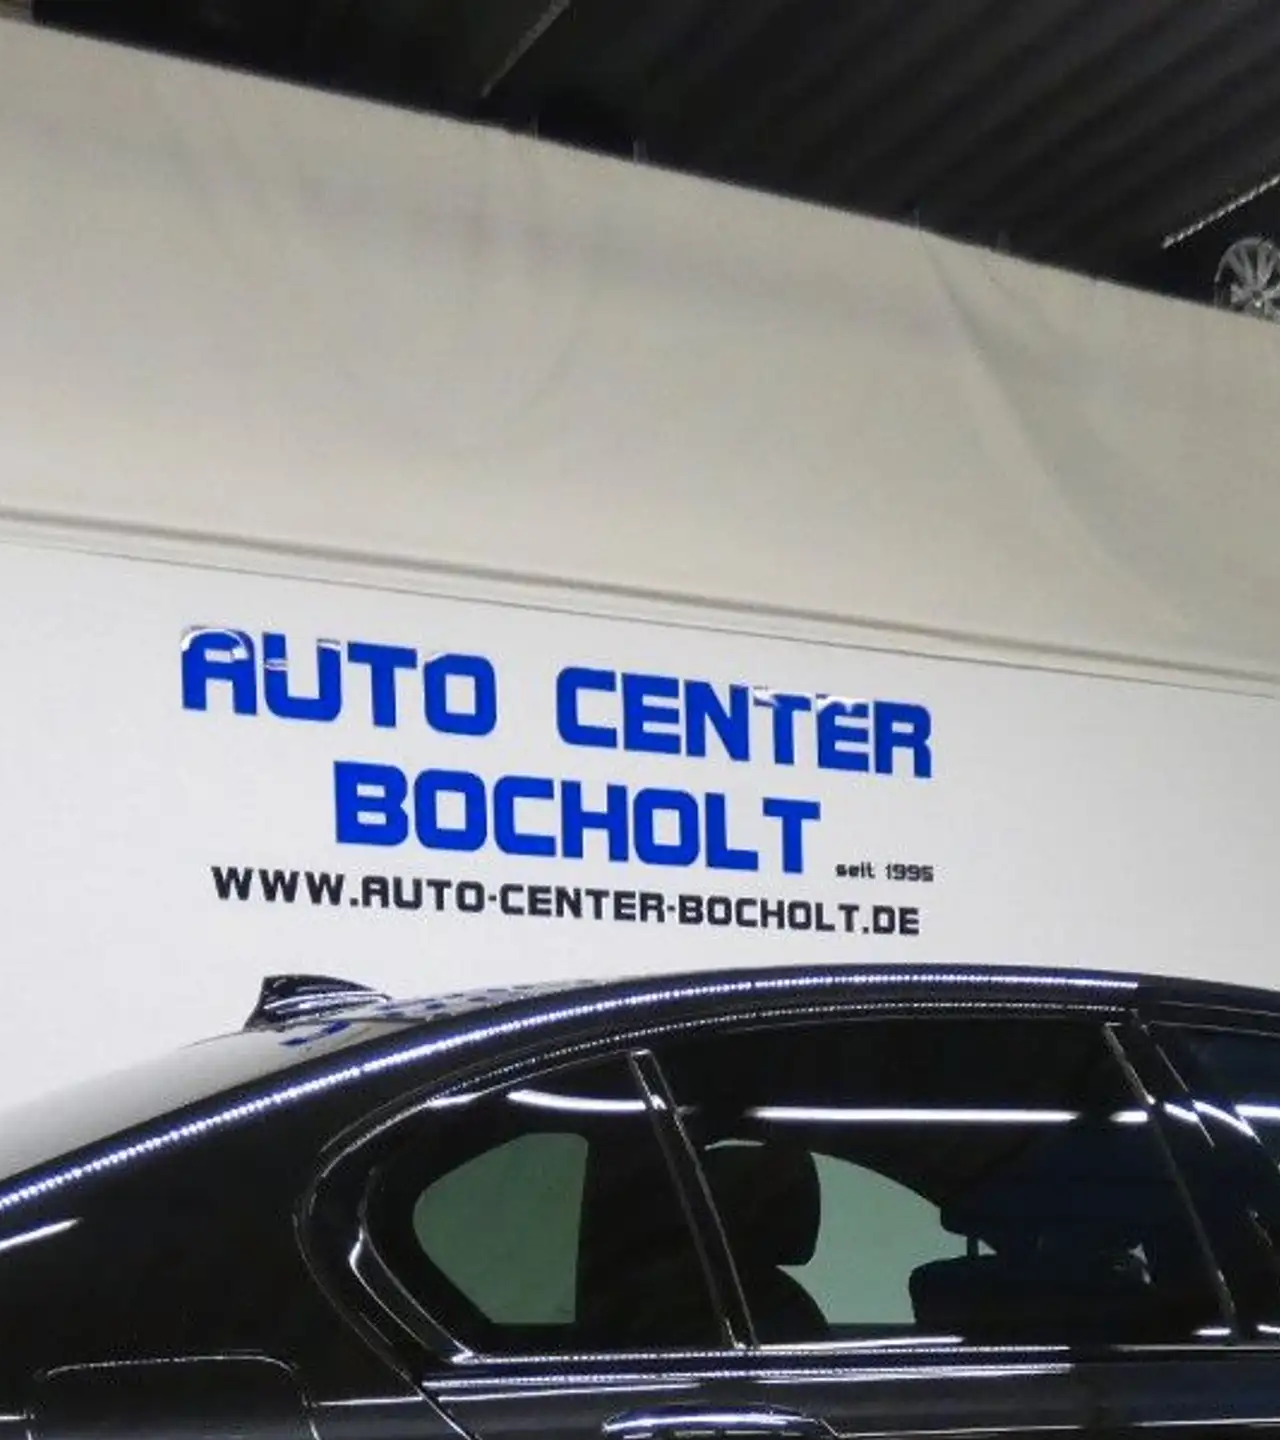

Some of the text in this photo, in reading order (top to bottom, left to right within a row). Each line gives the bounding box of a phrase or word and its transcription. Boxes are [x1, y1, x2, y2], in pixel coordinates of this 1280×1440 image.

[181, 627, 933, 779] AUTO CENTER
[332, 760, 822, 875] BOCHOLT
[211, 866, 921, 936] WWW.AUTO-CENTER-BOCHOLT.DE
[835, 861, 876, 879] seit
